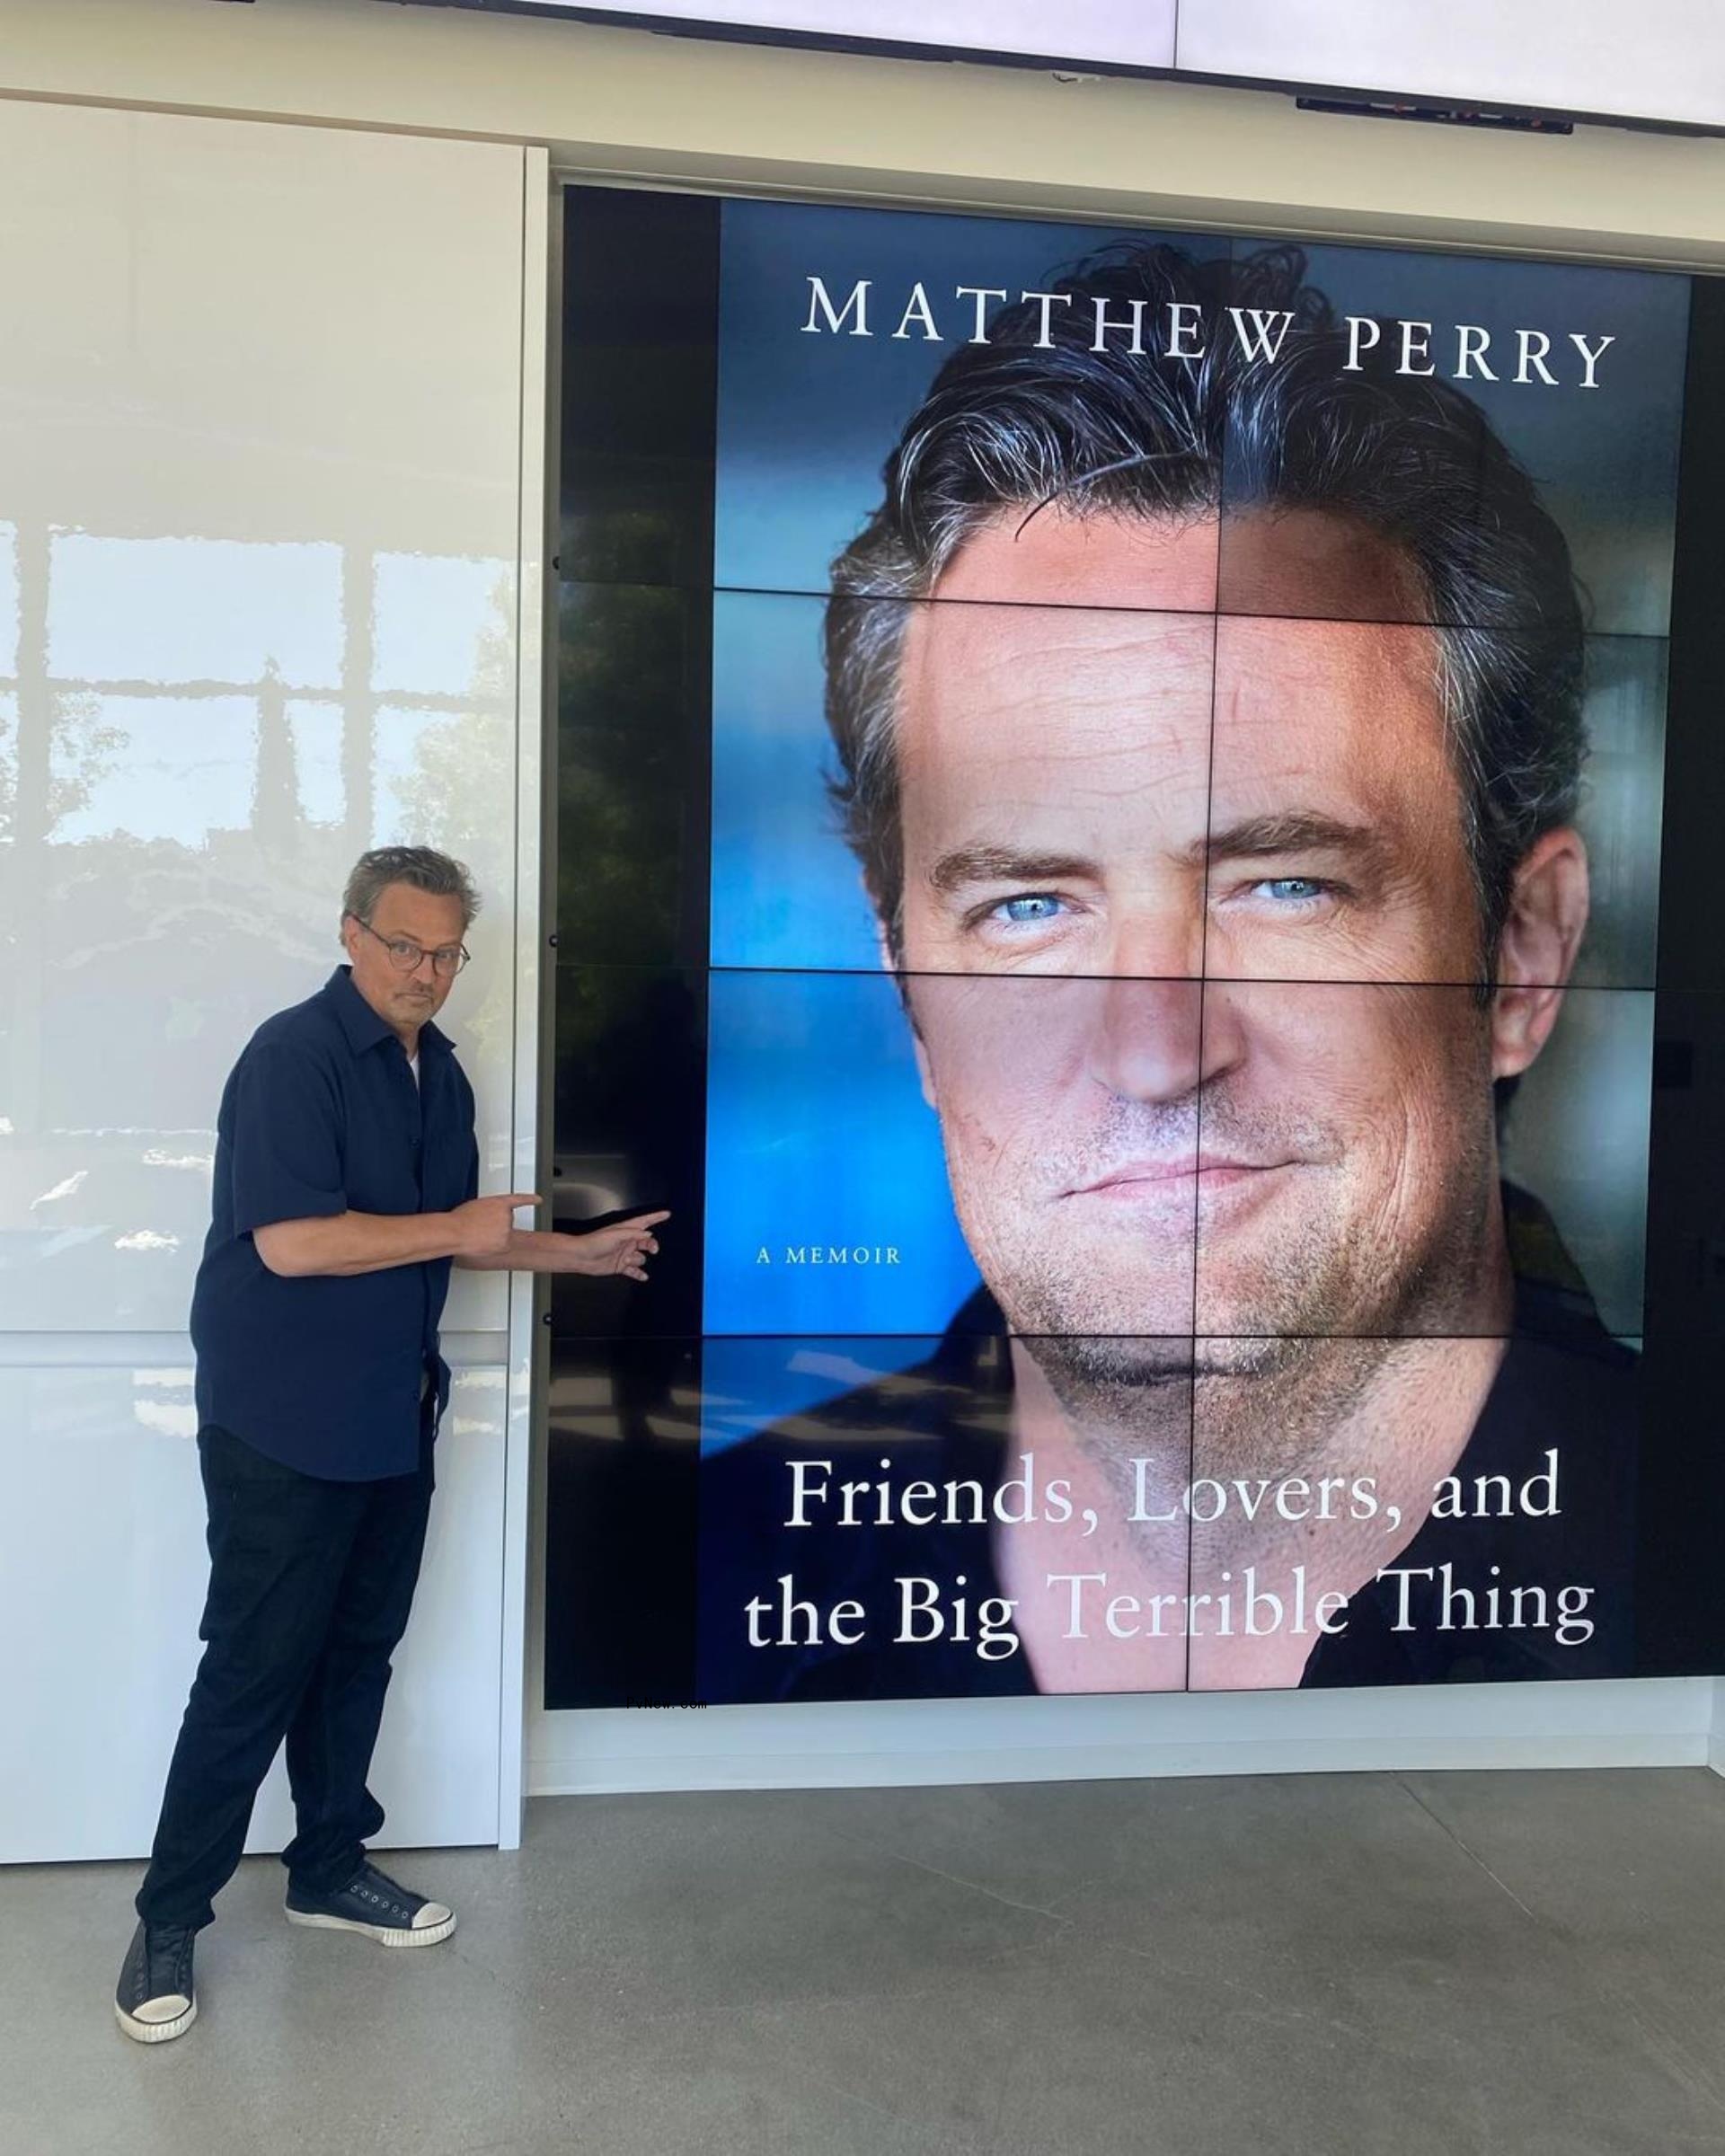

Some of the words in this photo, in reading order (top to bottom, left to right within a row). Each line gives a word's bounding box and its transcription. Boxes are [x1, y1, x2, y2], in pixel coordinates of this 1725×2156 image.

[801, 275, 1296, 365] MATTHEW
[1343, 315, 1616, 390] PERRY
[756, 1246, 771, 1264] A
[785, 1246, 901, 1265] MEMOIR
[783, 1454, 1100, 1537] Friends,
[1127, 1457, 1403, 1532] Lovers,
[1430, 1448, 1563, 1520] and
[744, 1576, 866, 1648] the
[892, 1576, 1021, 1661] Big
[1046, 1566, 1351, 1639] Terrible
[1376, 1563, 1597, 1647] Thing
